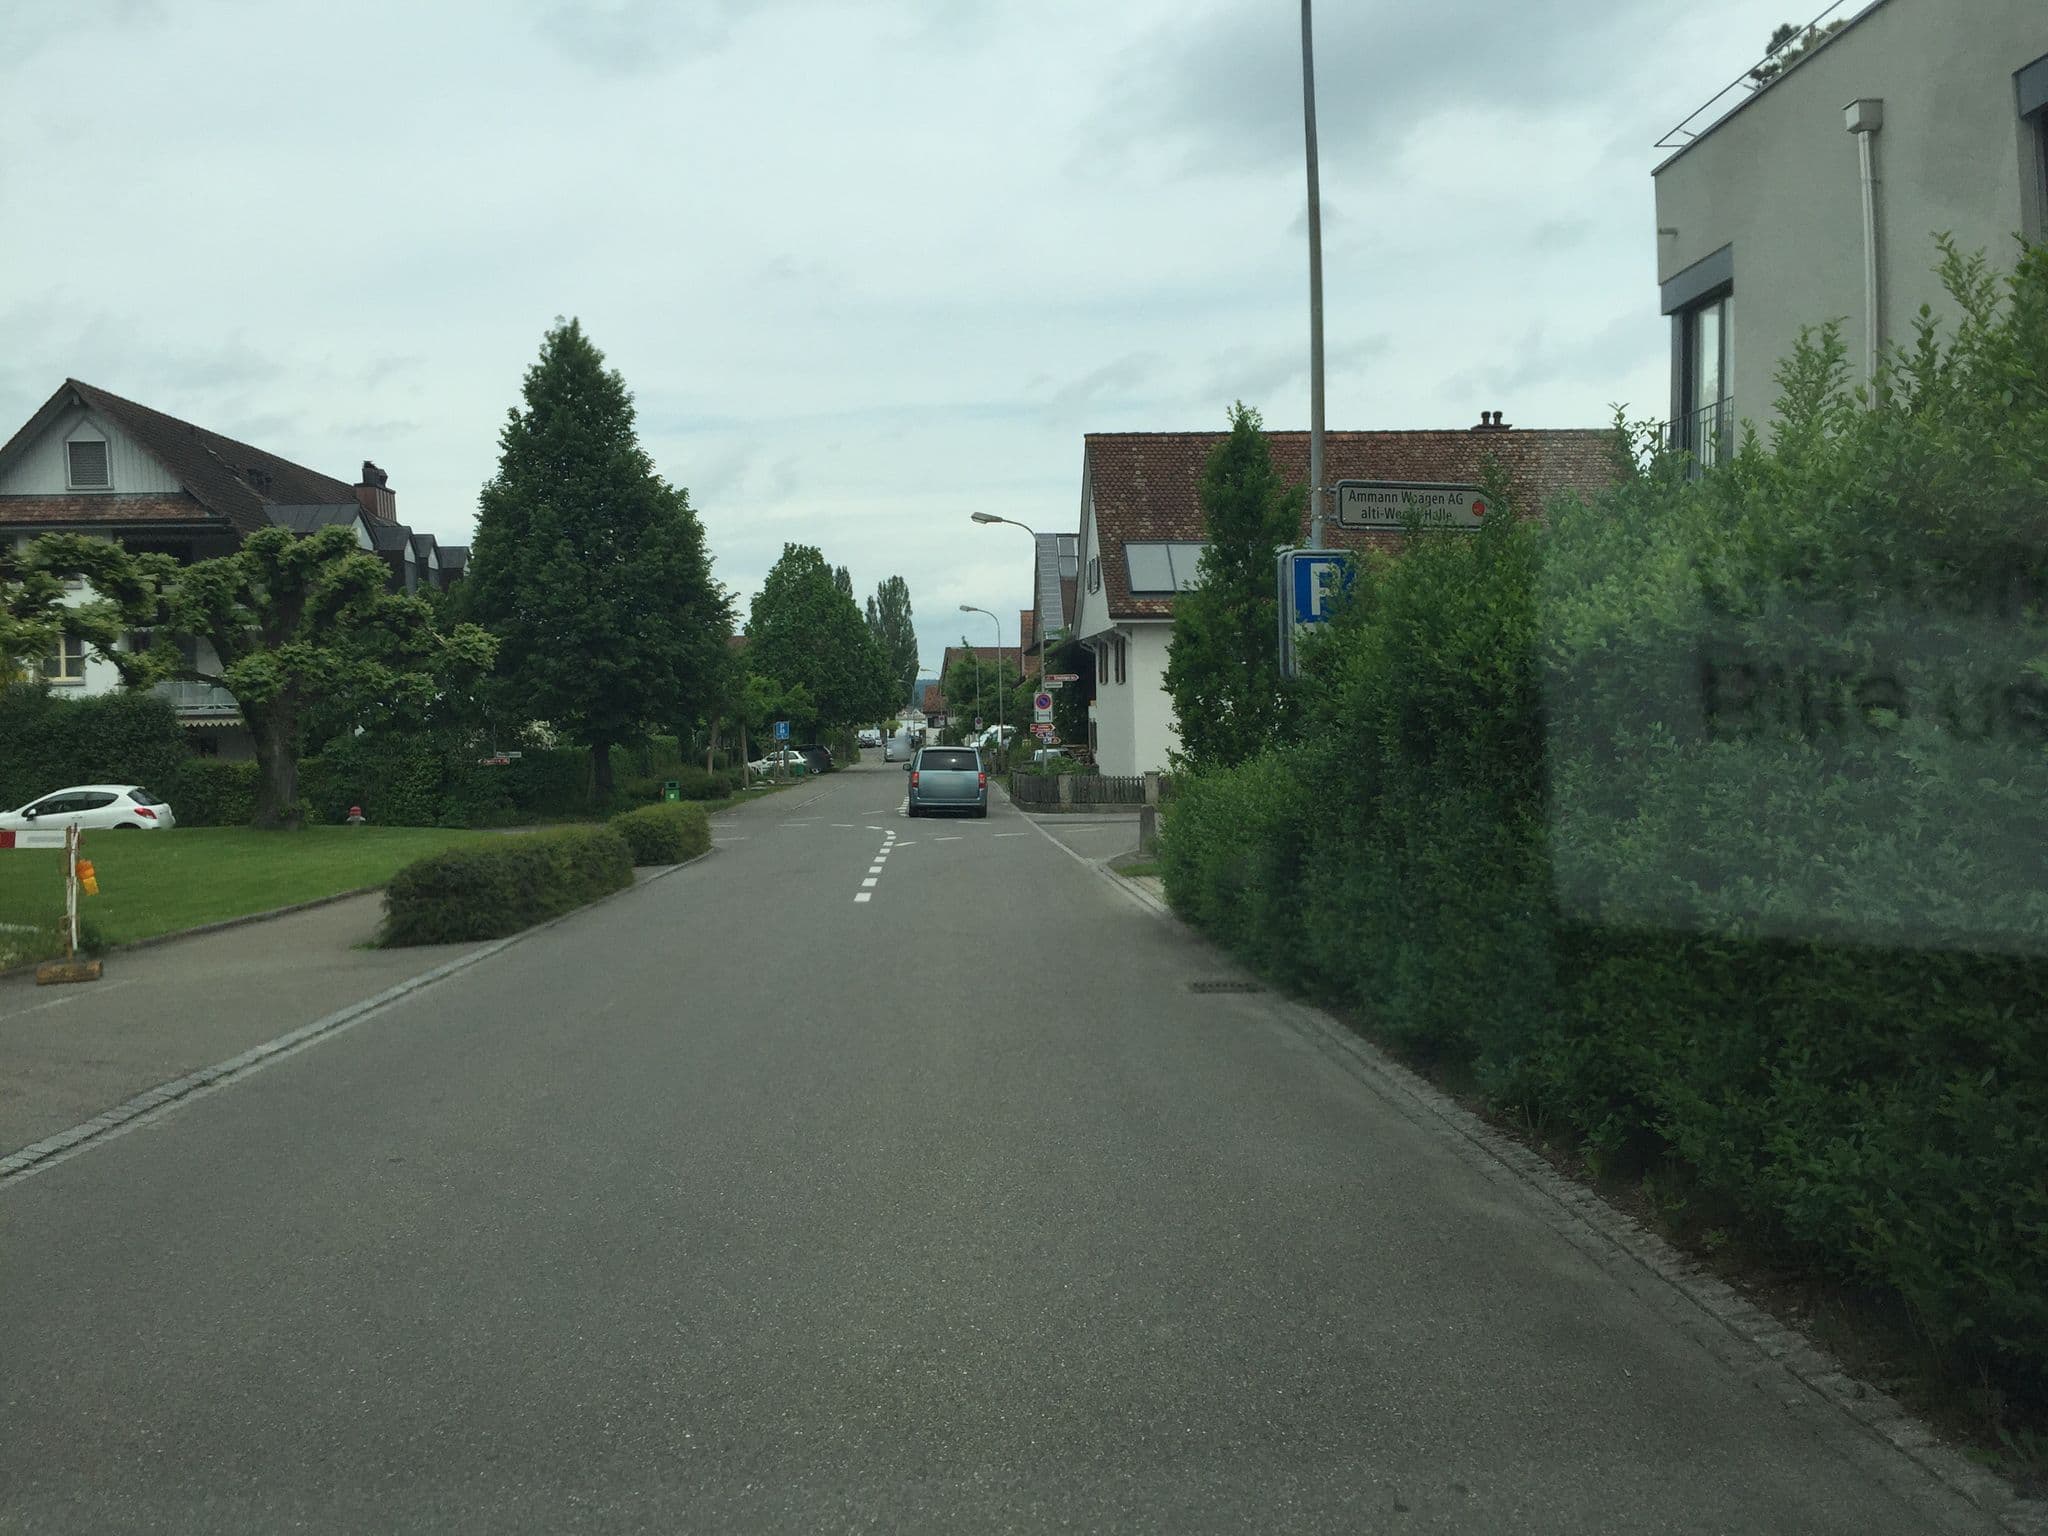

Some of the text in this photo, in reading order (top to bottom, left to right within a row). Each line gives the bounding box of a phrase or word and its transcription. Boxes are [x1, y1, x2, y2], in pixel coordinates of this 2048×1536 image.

[1348, 488, 1398, 504] Ammann
[1447, 492, 1464, 506] AG
[1310, 562, 1342, 616] P
